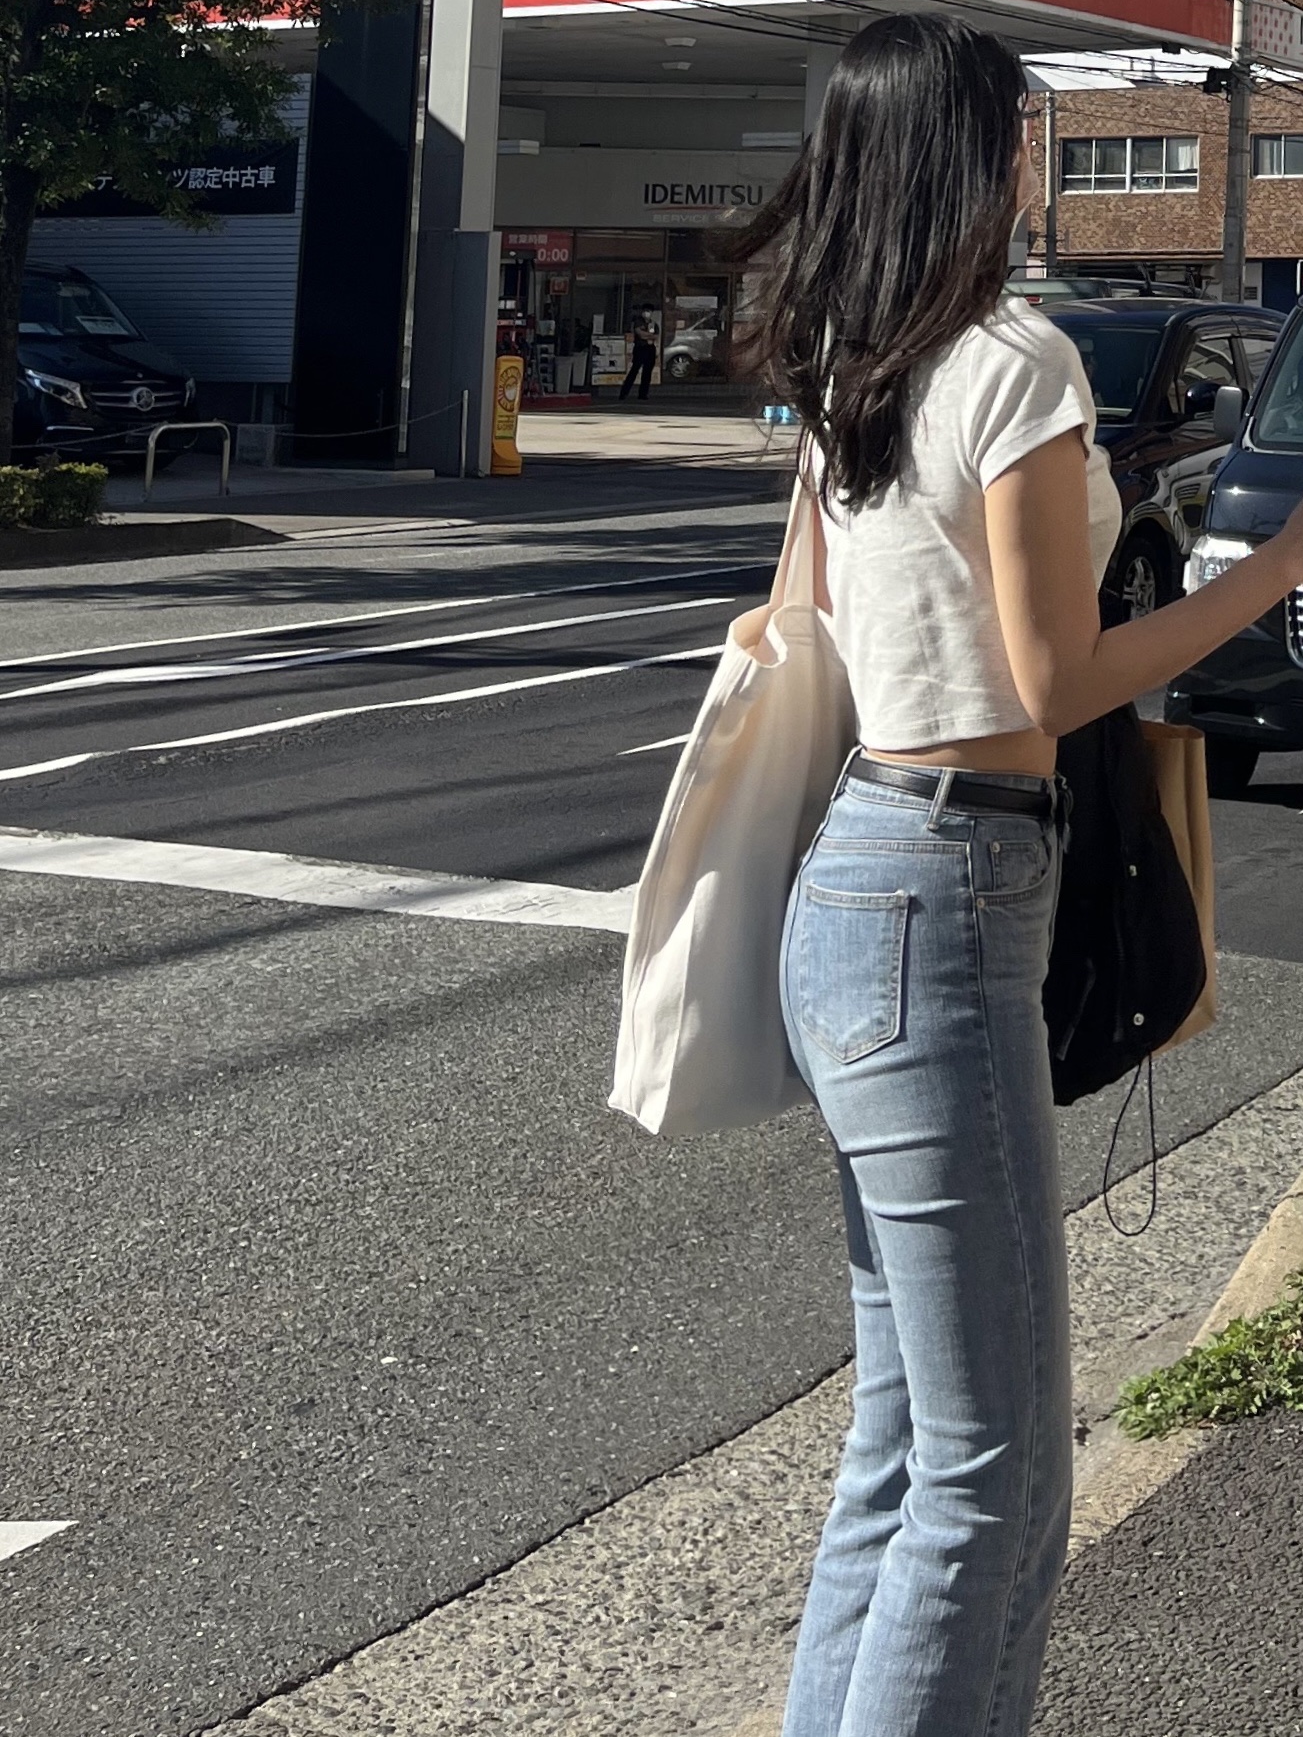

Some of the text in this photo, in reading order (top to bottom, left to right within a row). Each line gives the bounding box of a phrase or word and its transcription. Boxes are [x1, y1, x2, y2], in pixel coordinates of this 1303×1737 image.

[166, 165, 276, 189] ツ認定中古車
[643, 183, 763, 206] IDEMITSU
